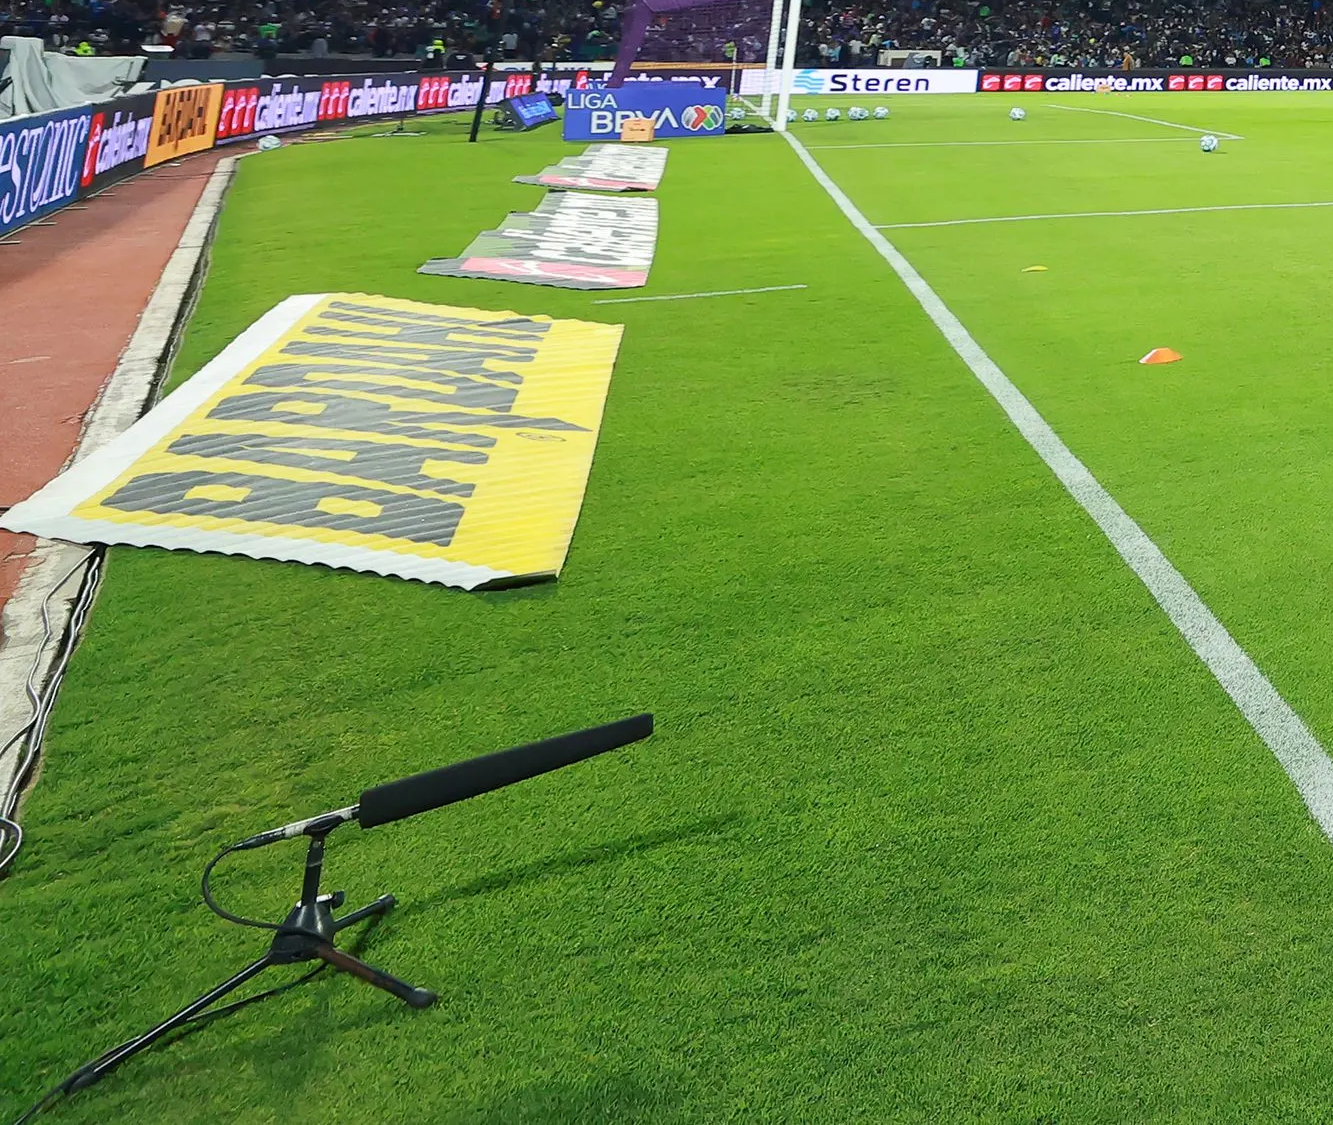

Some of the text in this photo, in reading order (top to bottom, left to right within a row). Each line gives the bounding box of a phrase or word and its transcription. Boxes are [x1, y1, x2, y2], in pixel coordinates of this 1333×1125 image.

[830, 74, 930, 92] Steren
[1045, 74, 1164, 92] caliente.mx
[1226, 74, 1332, 91] caliente.mx
[348, 78, 418, 118] caliente.mx
[567, 93, 618, 109] LIGA
[100, 301, 593, 547] BARDAHL
